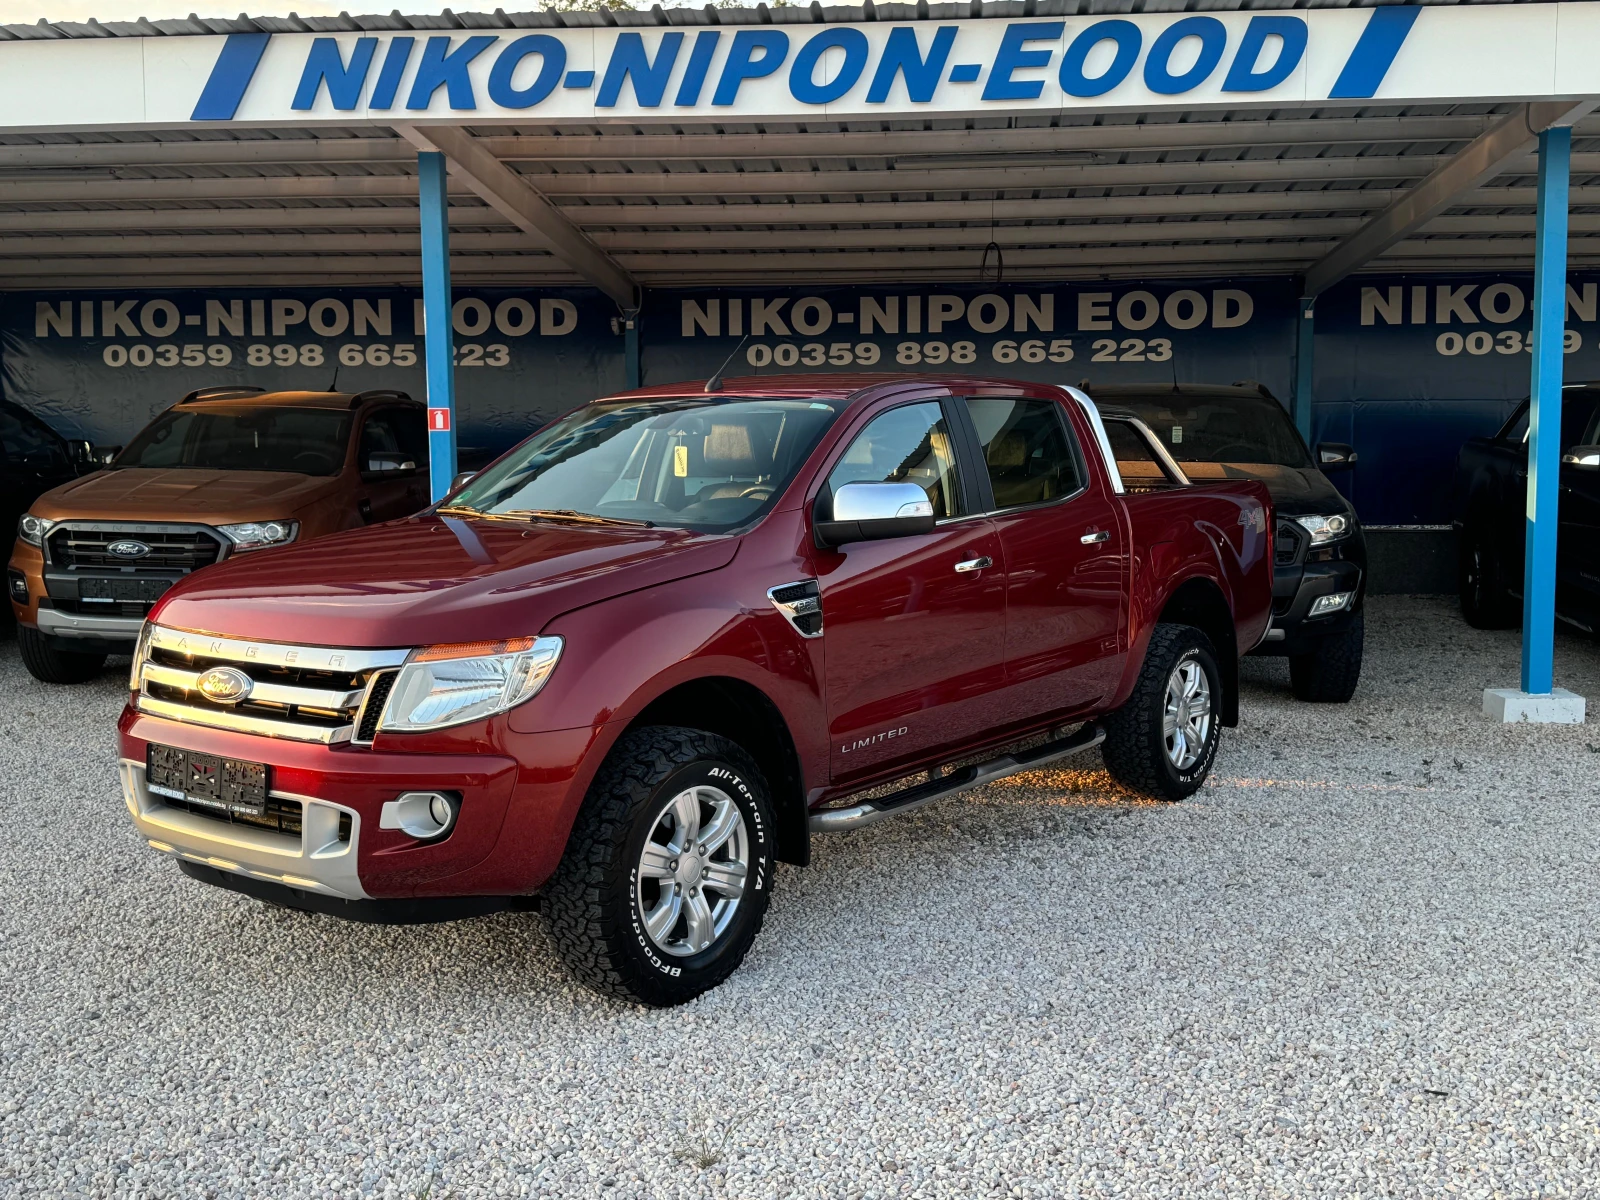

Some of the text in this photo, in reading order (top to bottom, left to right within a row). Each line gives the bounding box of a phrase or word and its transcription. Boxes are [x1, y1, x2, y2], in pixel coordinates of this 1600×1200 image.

[292, 17, 1308, 111] NIKO-NIPON-EOOD
[36, 299, 393, 337] NIKO-NIPON
[682, 290, 1254, 337] NIKO-NIPON EOOD
[103, 344, 511, 369] 00359 898 665 23
[747, 338, 1173, 368] 00359 898 665 223
[71, 523, 191, 534] RANGER
[115, 543, 139, 555] Ford
[206, 672, 236, 696] Ford
[841, 726, 908, 754] LIMITED
[707, 767, 767, 891] All-Terrain T/A
[629, 868, 683, 978] BFGoodrich
